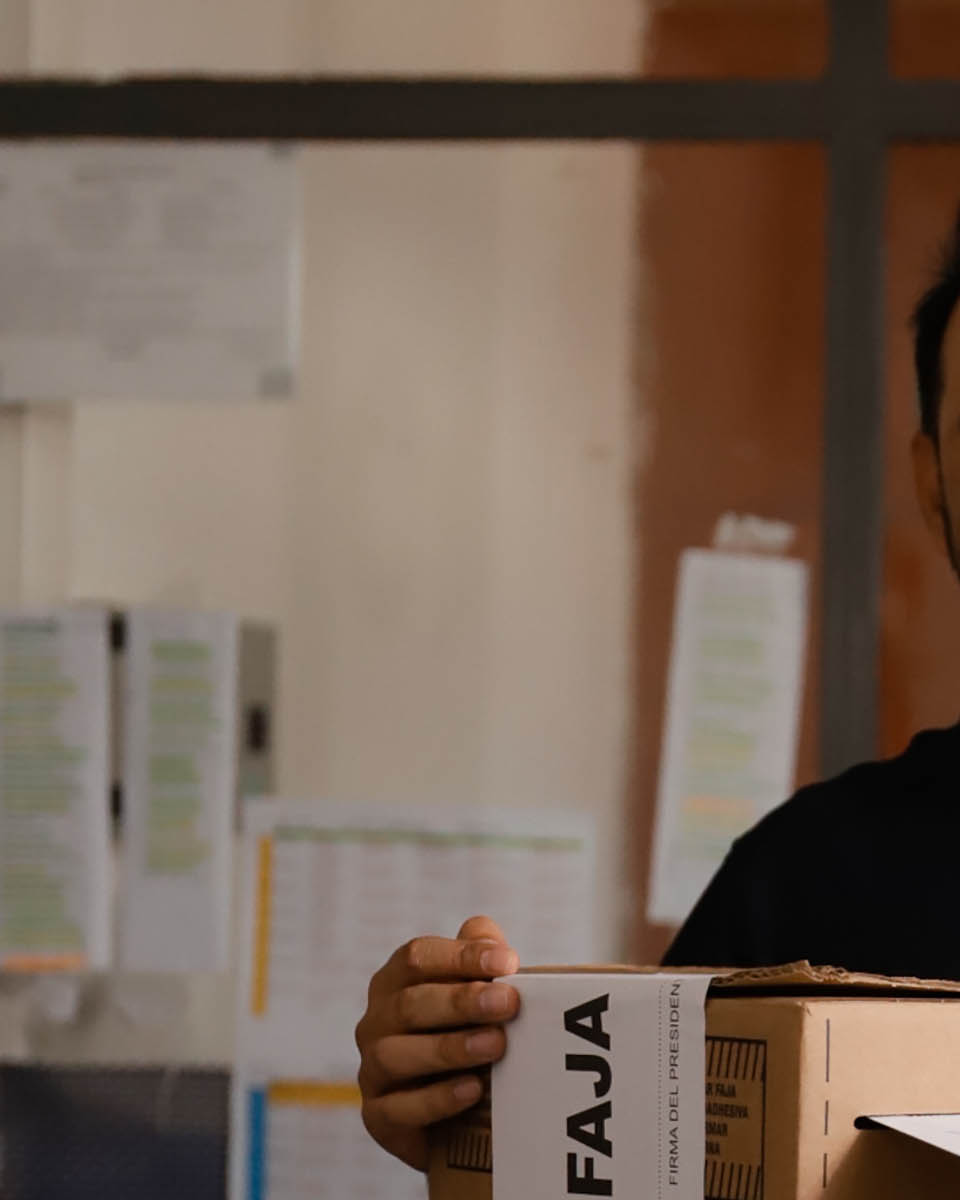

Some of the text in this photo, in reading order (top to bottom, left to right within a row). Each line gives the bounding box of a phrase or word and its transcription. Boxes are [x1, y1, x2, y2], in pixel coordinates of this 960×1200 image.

[563, 993, 614, 1197] FAJA
[668, 1085, 680, 1122] DEL
[668, 1126, 680, 1186] FIRMA
